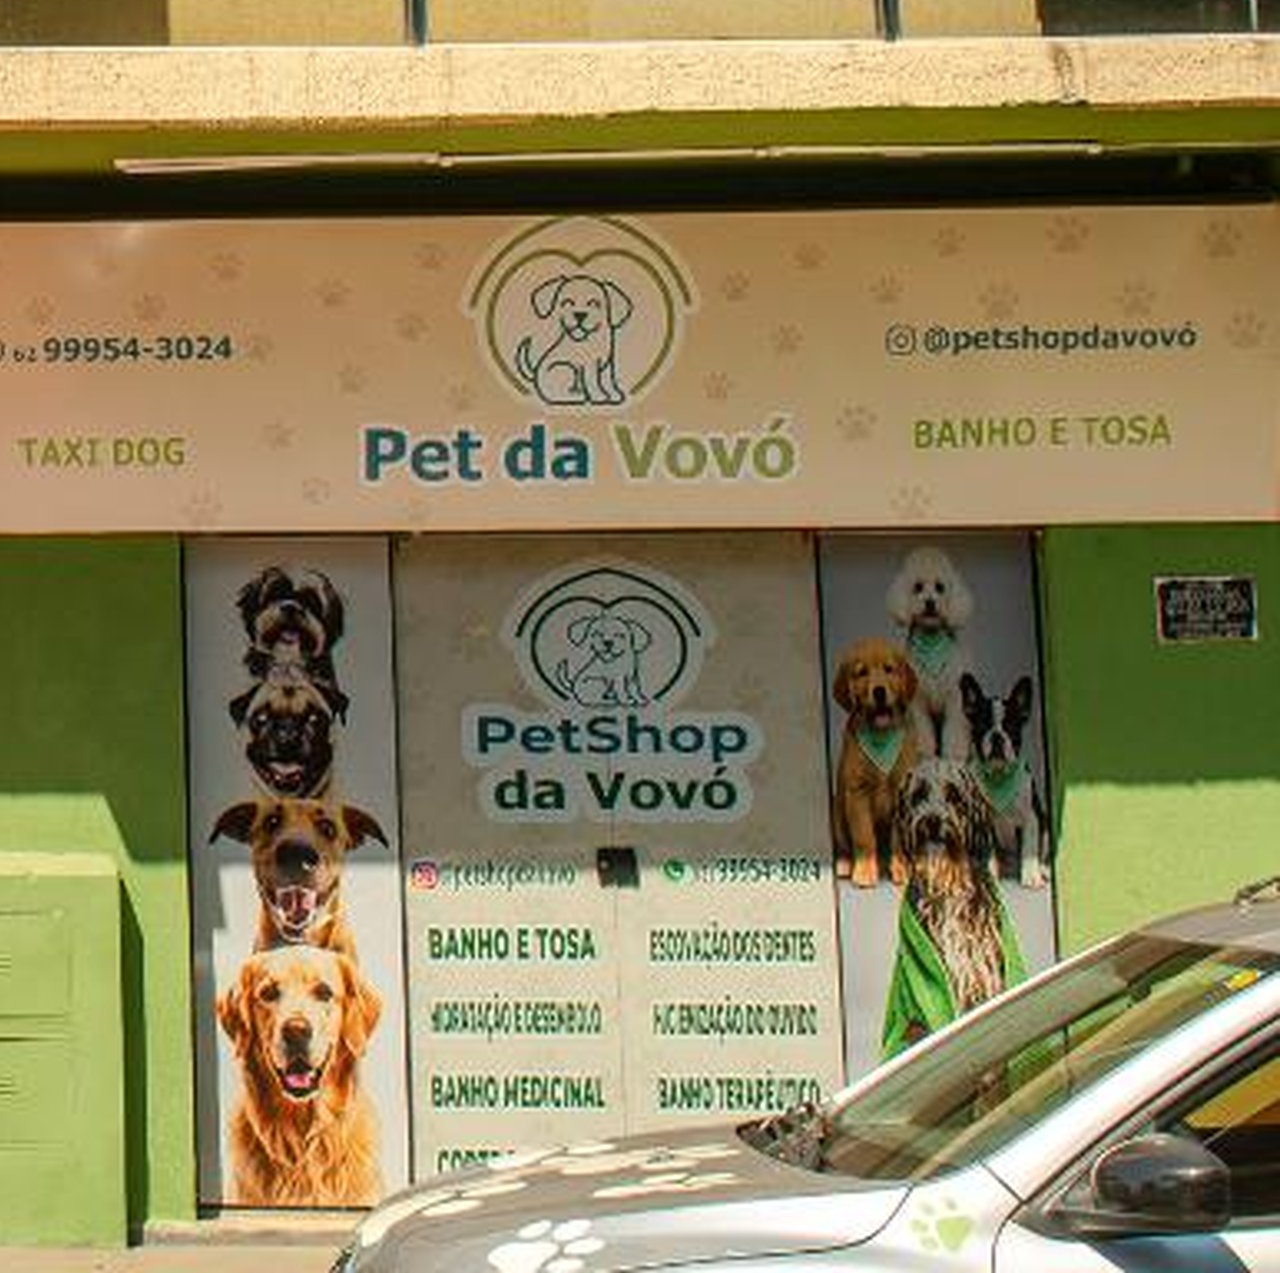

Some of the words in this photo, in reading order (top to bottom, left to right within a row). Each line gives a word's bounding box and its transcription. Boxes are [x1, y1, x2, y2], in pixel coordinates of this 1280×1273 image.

[43, 336, 233, 363] 99954-3024
[924, 321, 1197, 355] @petshopdavovó
[913, 417, 1037, 449] BANHO
[1050, 417, 1069, 446] E
[1079, 414, 1172, 446] TOSA
[17, 436, 100, 468] TAXI
[112, 436, 186, 467] DOG
[363, 426, 482, 482] Pet
[504, 424, 589, 481] da
[612, 416, 796, 480] Vovó
[477, 714, 748, 763] PetShop
[494, 769, 566, 812] da
[586, 765, 738, 812] Vovó
[429, 928, 510, 960] BANHO
[517, 928, 530, 960] E
[535, 928, 596, 960] TOSA
[431, 1076, 499, 1108] BANHO
[503, 1076, 606, 1108] MEDICINAL
[658, 1077, 713, 1109] BANHO
